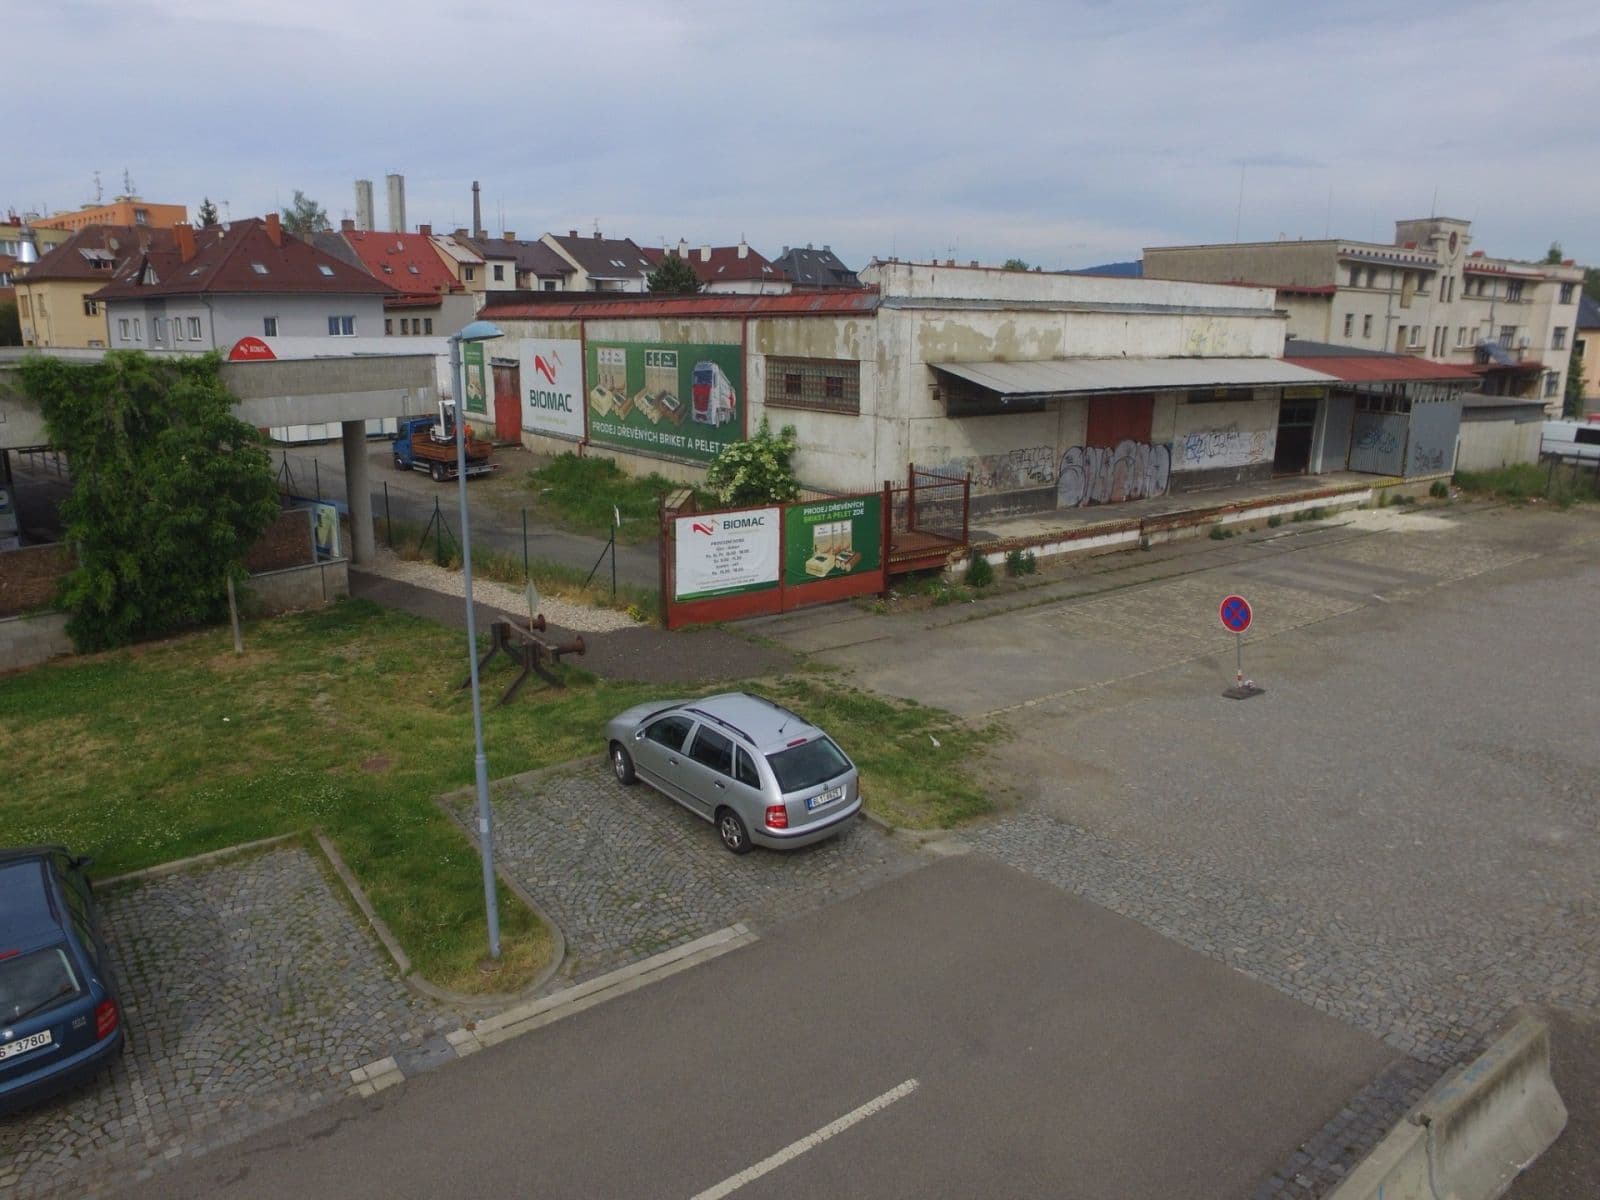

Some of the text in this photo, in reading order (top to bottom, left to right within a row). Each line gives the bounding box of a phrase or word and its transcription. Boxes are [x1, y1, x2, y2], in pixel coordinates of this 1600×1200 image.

[529, 389, 573, 413] BIOMAC
[592, 421, 616, 435] PRODEJ
[659, 432, 686, 447] BRIKET
[688, 439, 694, 448] A
[695, 439, 720, 453] PELET
[803, 505, 828, 516] PRODEJ
[852, 508, 865, 516] ZDE
[723, 517, 765, 530] BIOMAC
[16, 1033, 46, 1052] 3780
